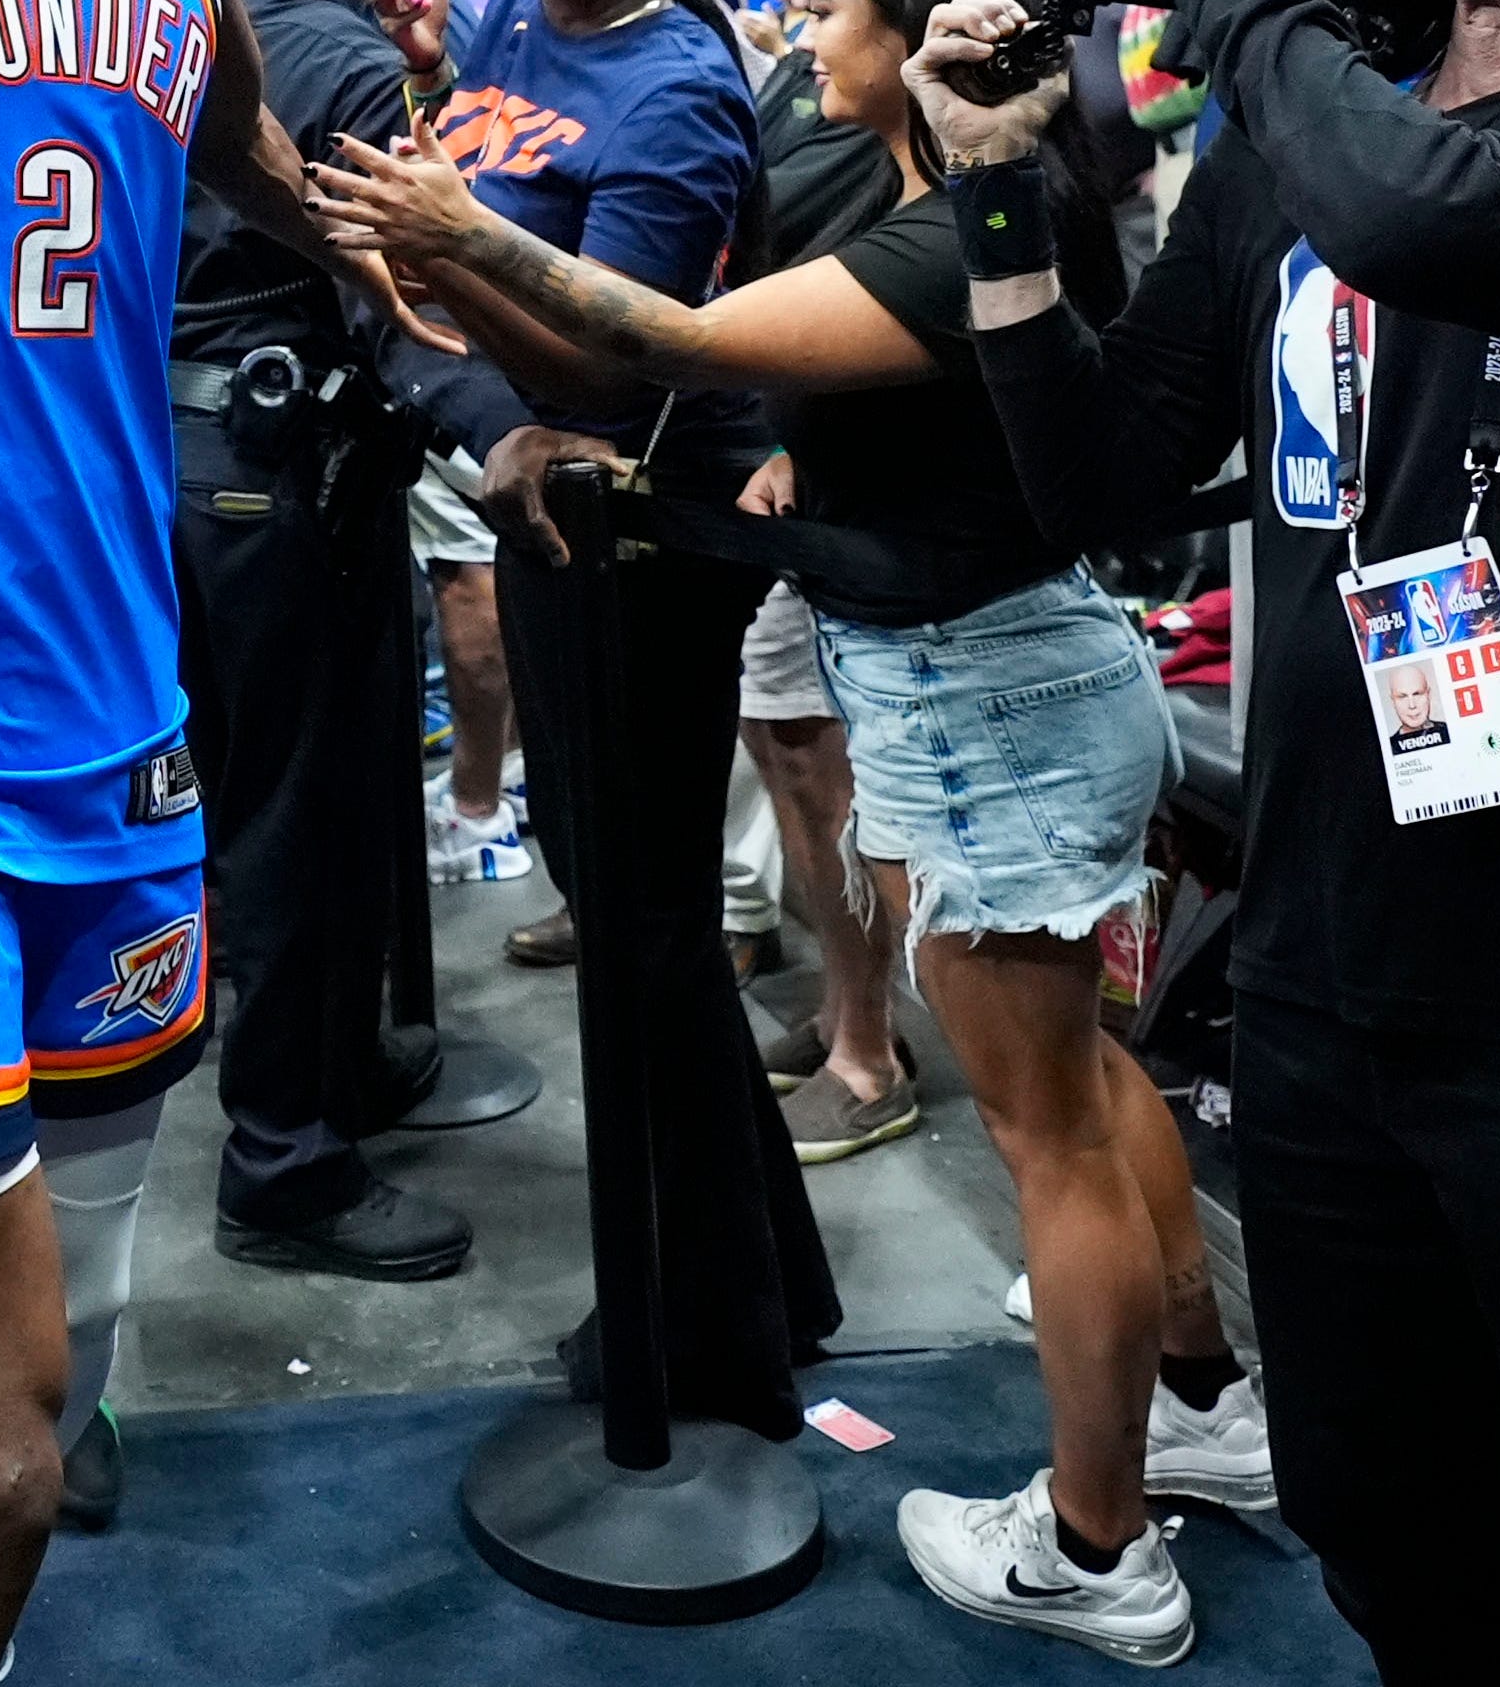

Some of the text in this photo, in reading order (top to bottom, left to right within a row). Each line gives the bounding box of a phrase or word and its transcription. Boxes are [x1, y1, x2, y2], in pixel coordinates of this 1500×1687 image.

[11, 139, 101, 337] 2
[1335, 307, 1352, 414] 2023-24 SEASON
[1285, 455, 1331, 507] NBA
[1365, 610, 1407, 636] 2023-24
[1398, 731, 1443, 752] VENDOR
[113, 934, 186, 1012] OKC
